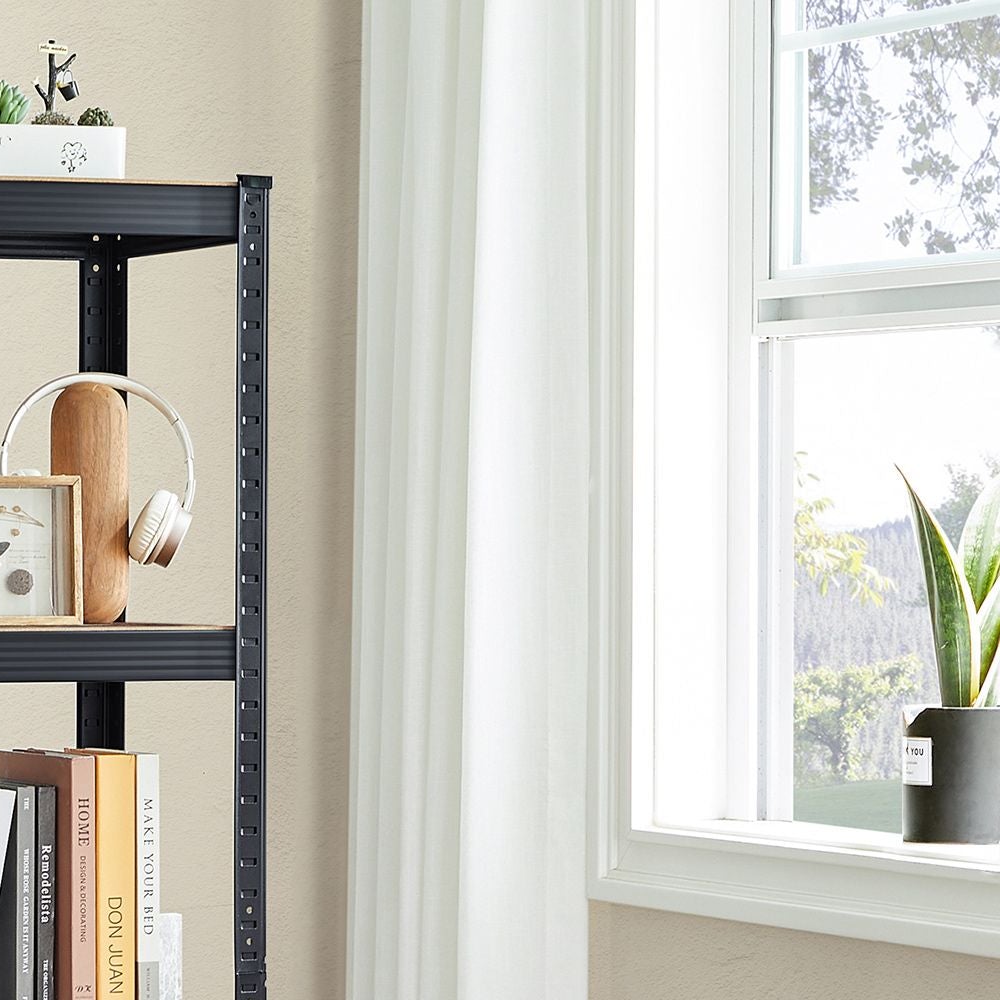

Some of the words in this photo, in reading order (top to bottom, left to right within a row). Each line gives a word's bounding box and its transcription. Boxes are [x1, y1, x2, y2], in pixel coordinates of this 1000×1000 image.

[911, 748, 923, 756] YOU
[78, 798, 89, 847] HOME
[143, 798, 154, 845] MAKE
[41, 845, 52, 923] Remodelista
[143, 854, 154, 900] YOUR
[108, 897, 122, 938] DON
[144, 907, 154, 935] BED
[108, 944, 123, 993] JUAN
